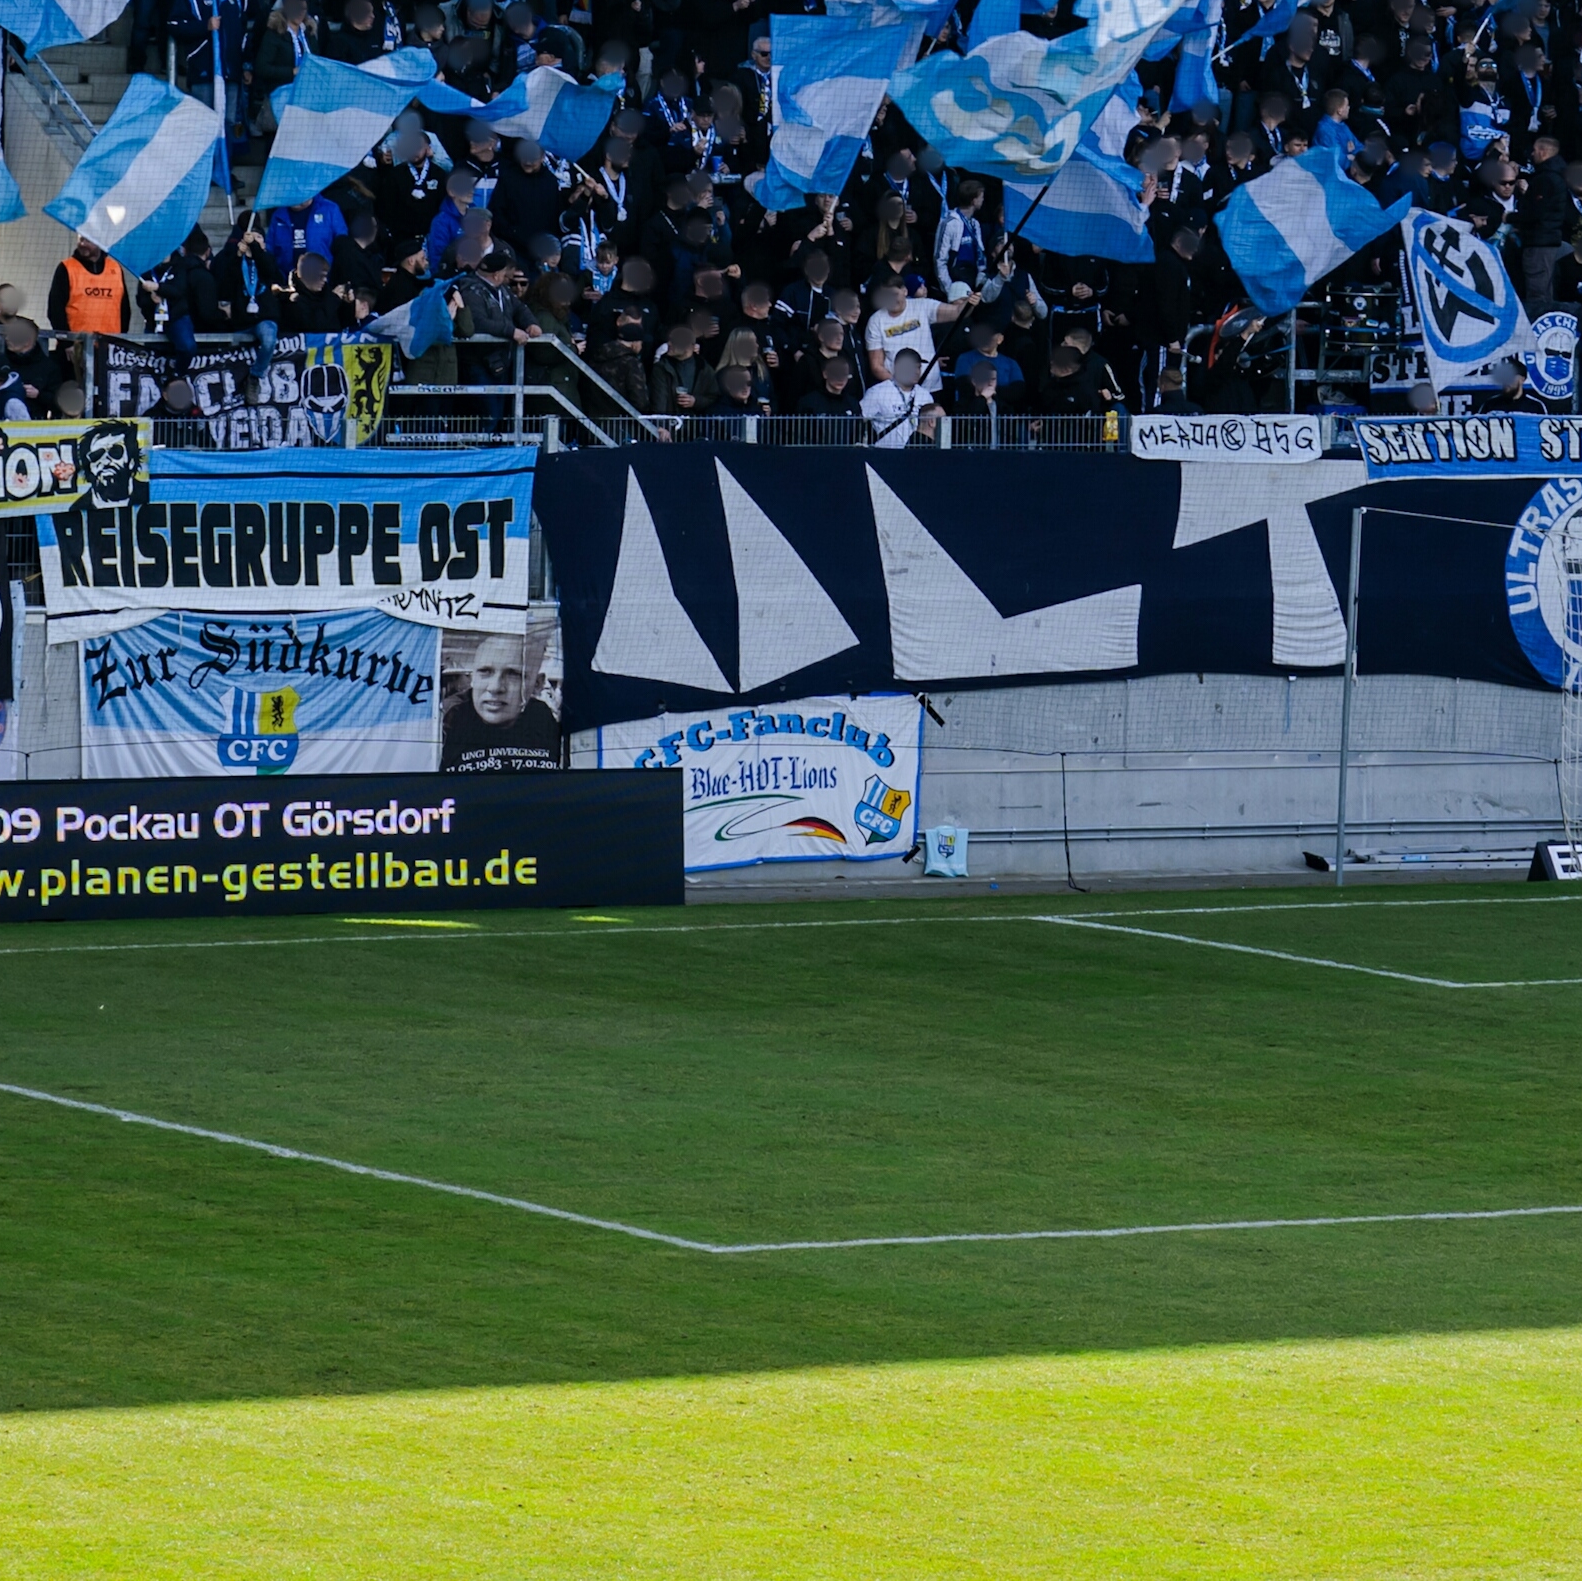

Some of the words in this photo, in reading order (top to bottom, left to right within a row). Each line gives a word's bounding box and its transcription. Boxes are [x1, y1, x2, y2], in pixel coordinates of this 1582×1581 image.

[84, 286, 113, 298] GÖTZ
[1358, 417, 1518, 465] SEKTION
[51, 502, 403, 589] REISEGRUPPE
[419, 497, 515, 582] OST
[84, 637, 180, 712] Zur
[188, 619, 435, 705] Südkurve
[226, 738, 289, 763] CFC
[461, 750, 486, 762] UNGI
[633, 709, 896, 768] CFC-Fanclub
[690, 756, 839, 801] Blue-HOT-Lions
[56, 805, 200, 842] Pockau
[214, 802, 269, 839] OT
[282, 799, 457, 838] Görsdorf
[858, 808, 895, 835] CFC
